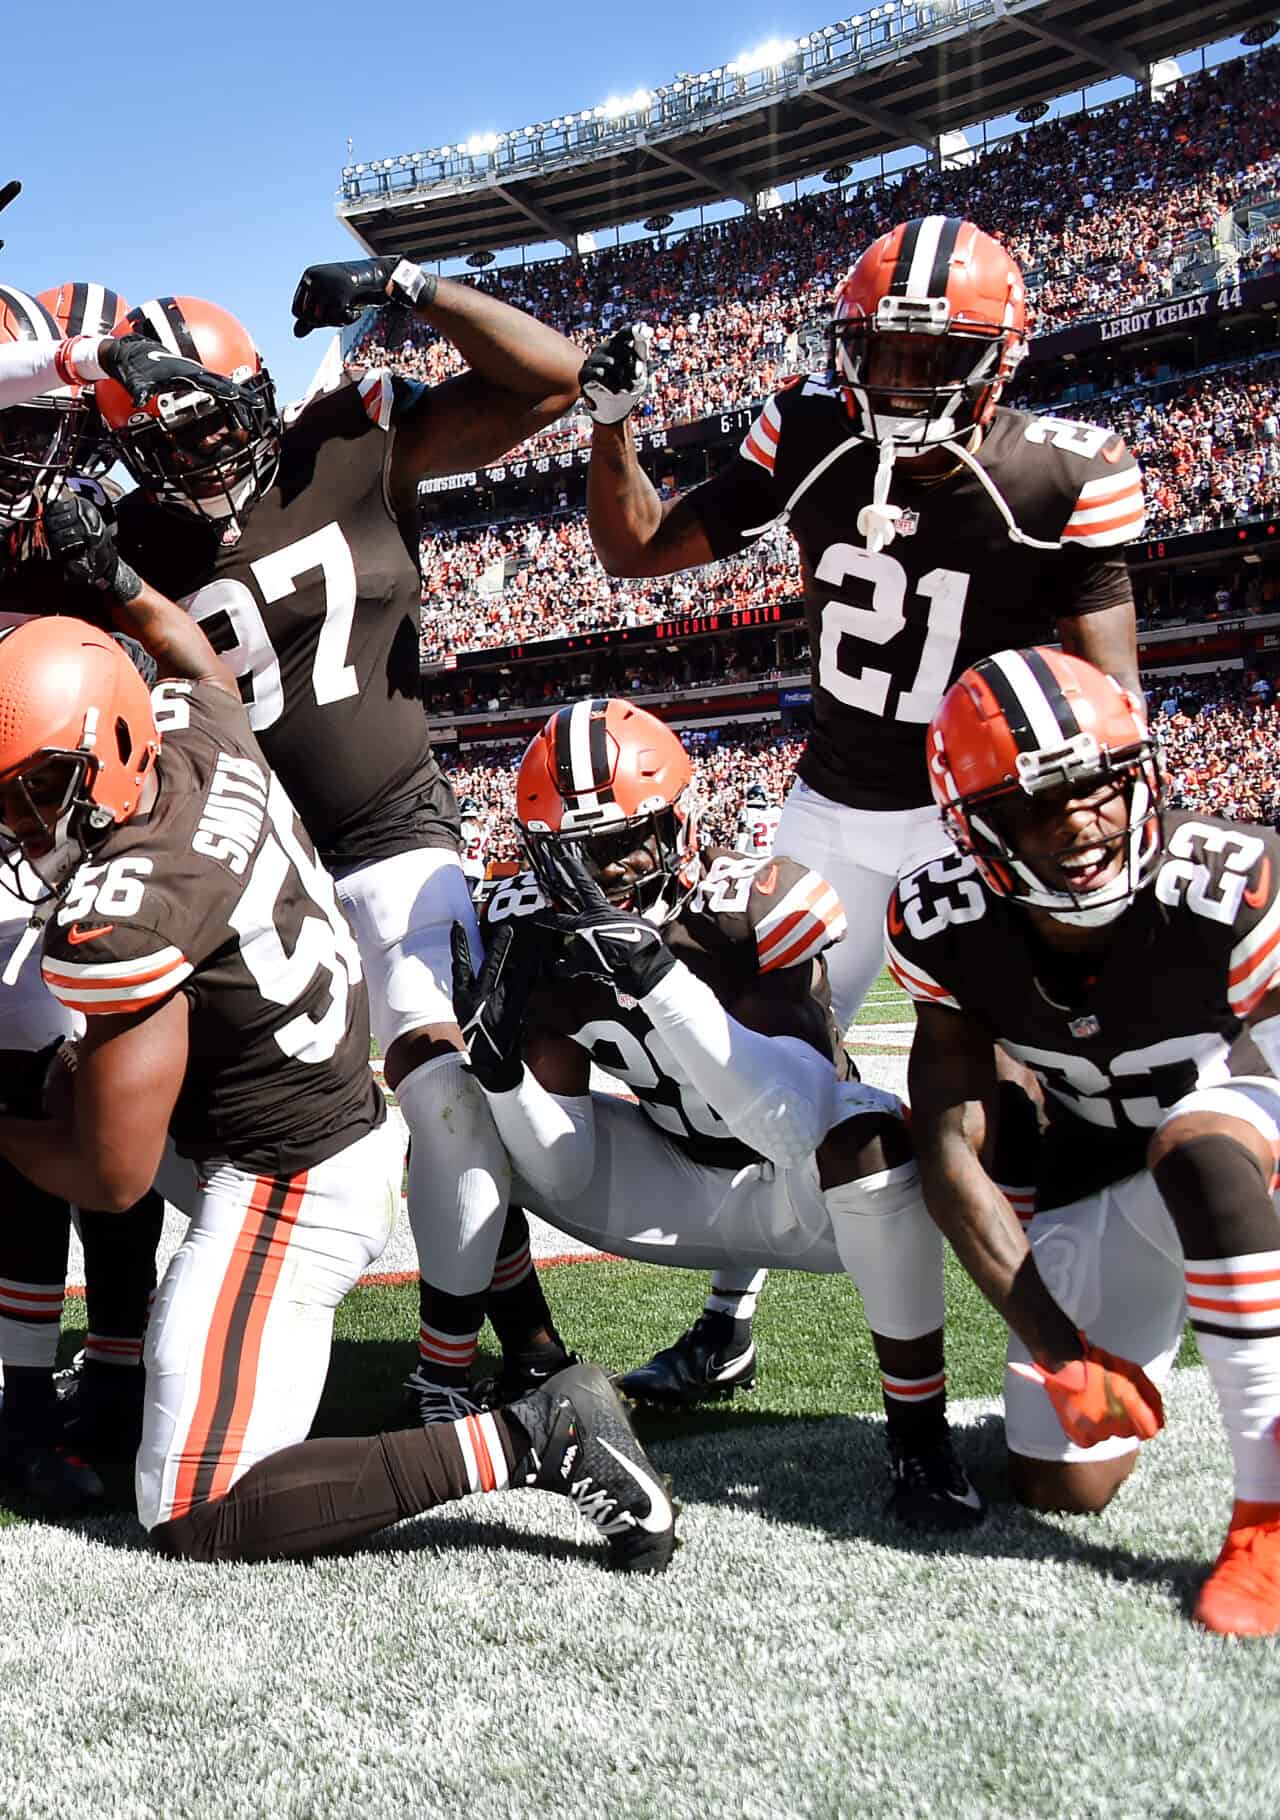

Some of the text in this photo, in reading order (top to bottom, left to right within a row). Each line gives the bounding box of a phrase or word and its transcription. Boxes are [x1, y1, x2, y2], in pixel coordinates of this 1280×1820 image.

[1100, 286, 1242, 341] LEROY KELLY 44
[721, 410, 752, 433] 6:17
[417, 472, 477, 495] IONSHIPS
[510, 463, 527, 479] '47
[656, 606, 781, 638] MALCOLM SMITH
[814, 542, 970, 724] 21
[191, 752, 270, 876] SMITH
[57, 857, 153, 927] 56
[899, 852, 986, 940] 23
[1155, 821, 1264, 925] 23
